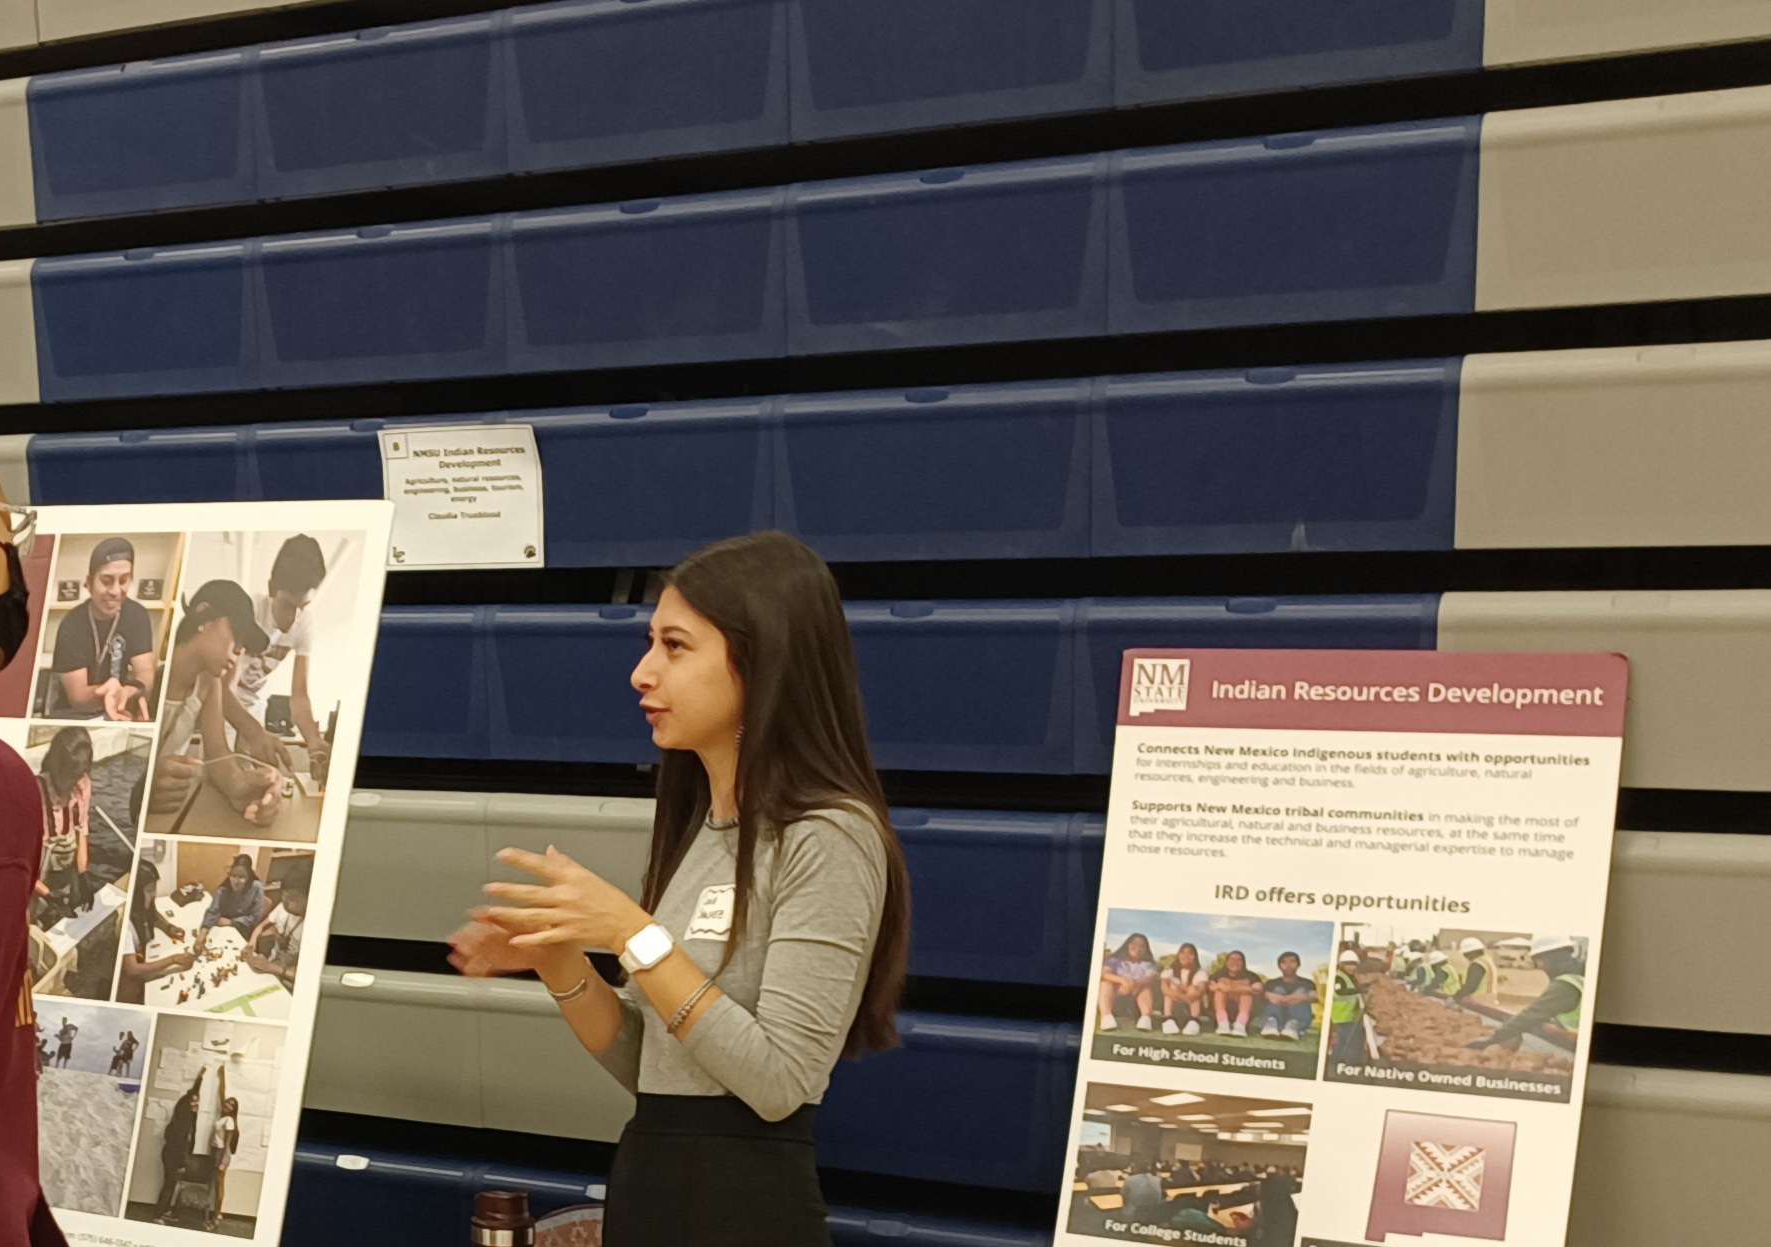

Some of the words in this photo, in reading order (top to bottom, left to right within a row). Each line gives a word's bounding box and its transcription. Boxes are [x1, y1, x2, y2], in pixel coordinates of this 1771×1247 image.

[444, 448, 474, 457] Indian
[477, 446, 525, 455] Resources
[439, 459, 501, 469] Development
[1136, 663, 1187, 685] NM
[1133, 685, 1186, 698] STATE
[1211, 680, 1286, 700] Indian
[1293, 681, 1420, 702] Resources
[1427, 682, 1604, 710] Development
[1136, 757, 1153, 768] for
[1155, 758, 1221, 772] internships
[1225, 760, 1248, 771] and
[1251, 761, 1312, 773] education
[1315, 762, 1327, 773] in
[1330, 763, 1351, 774] the
[1354, 763, 1388, 775] fields
[1391, 764, 1405, 775] of
[1407, 764, 1481, 779] agriculture,
[1484, 767, 1532, 779] natural
[1137, 743, 1200, 756] Connects
[1204, 745, 1234, 757] New
[1239, 746, 1289, 758] Mexico
[1293, 748, 1372, 761] Indigenous
[1376, 750, 1442, 762] students
[1446, 752, 1480, 763] with
[1484, 753, 1591, 769] opportunities
[1198, 774, 1269, 788] engineering
[1272, 775, 1295, 786] and
[1132, 800, 1192, 814] Supports
[1196, 802, 1228, 814] New
[1232, 803, 1281, 816] Mexico
[1285, 805, 1324, 818] tribal
[1328, 808, 1424, 821] communities
[1428, 811, 1441, 822] in
[1444, 813, 1495, 827] making
[1498, 815, 1521, 826] the
[1524, 816, 1560, 828] most
[1564, 816, 1580, 828] of
[1130, 815, 1158, 826] their
[1238, 819, 1284, 831] natural
[1287, 820, 1312, 832] and
[1315, 822, 1372, 834] business
[1449, 828, 1462, 839] at
[1466, 829, 1489, 840] the
[1493, 831, 1530, 842] same
[1534, 831, 1565, 843] time
[1127, 843, 1161, 854] those
[1128, 829, 1153, 840] that
[1156, 830, 1182, 843] they
[1186, 831, 1238, 844] increase
[1241, 834, 1262, 845] the
[1265, 835, 1323, 847] technical
[1326, 837, 1351, 849] and
[1355, 839, 1429, 854] managerial
[1433, 842, 1496, 856] expertise
[1500, 845, 1514, 857] to
[1518, 847, 1575, 862] manage
[1214, 884, 1250, 901] IRD
[1255, 886, 1316, 905] offers
[1322, 892, 1471, 914] opportunities
[1112, 1043, 1135, 1057] For
[1138, 1046, 1170, 1062] High
[1173, 1049, 1219, 1065] School
[1222, 1053, 1286, 1071] Students
[1336, 1063, 1362, 1077] For
[1364, 1065, 1415, 1082] Native
[1418, 1070, 1472, 1087] Owned
[1476, 1075, 1562, 1095] Businesses
[1105, 1219, 1128, 1232] For
[1130, 1222, 1181, 1241] College
